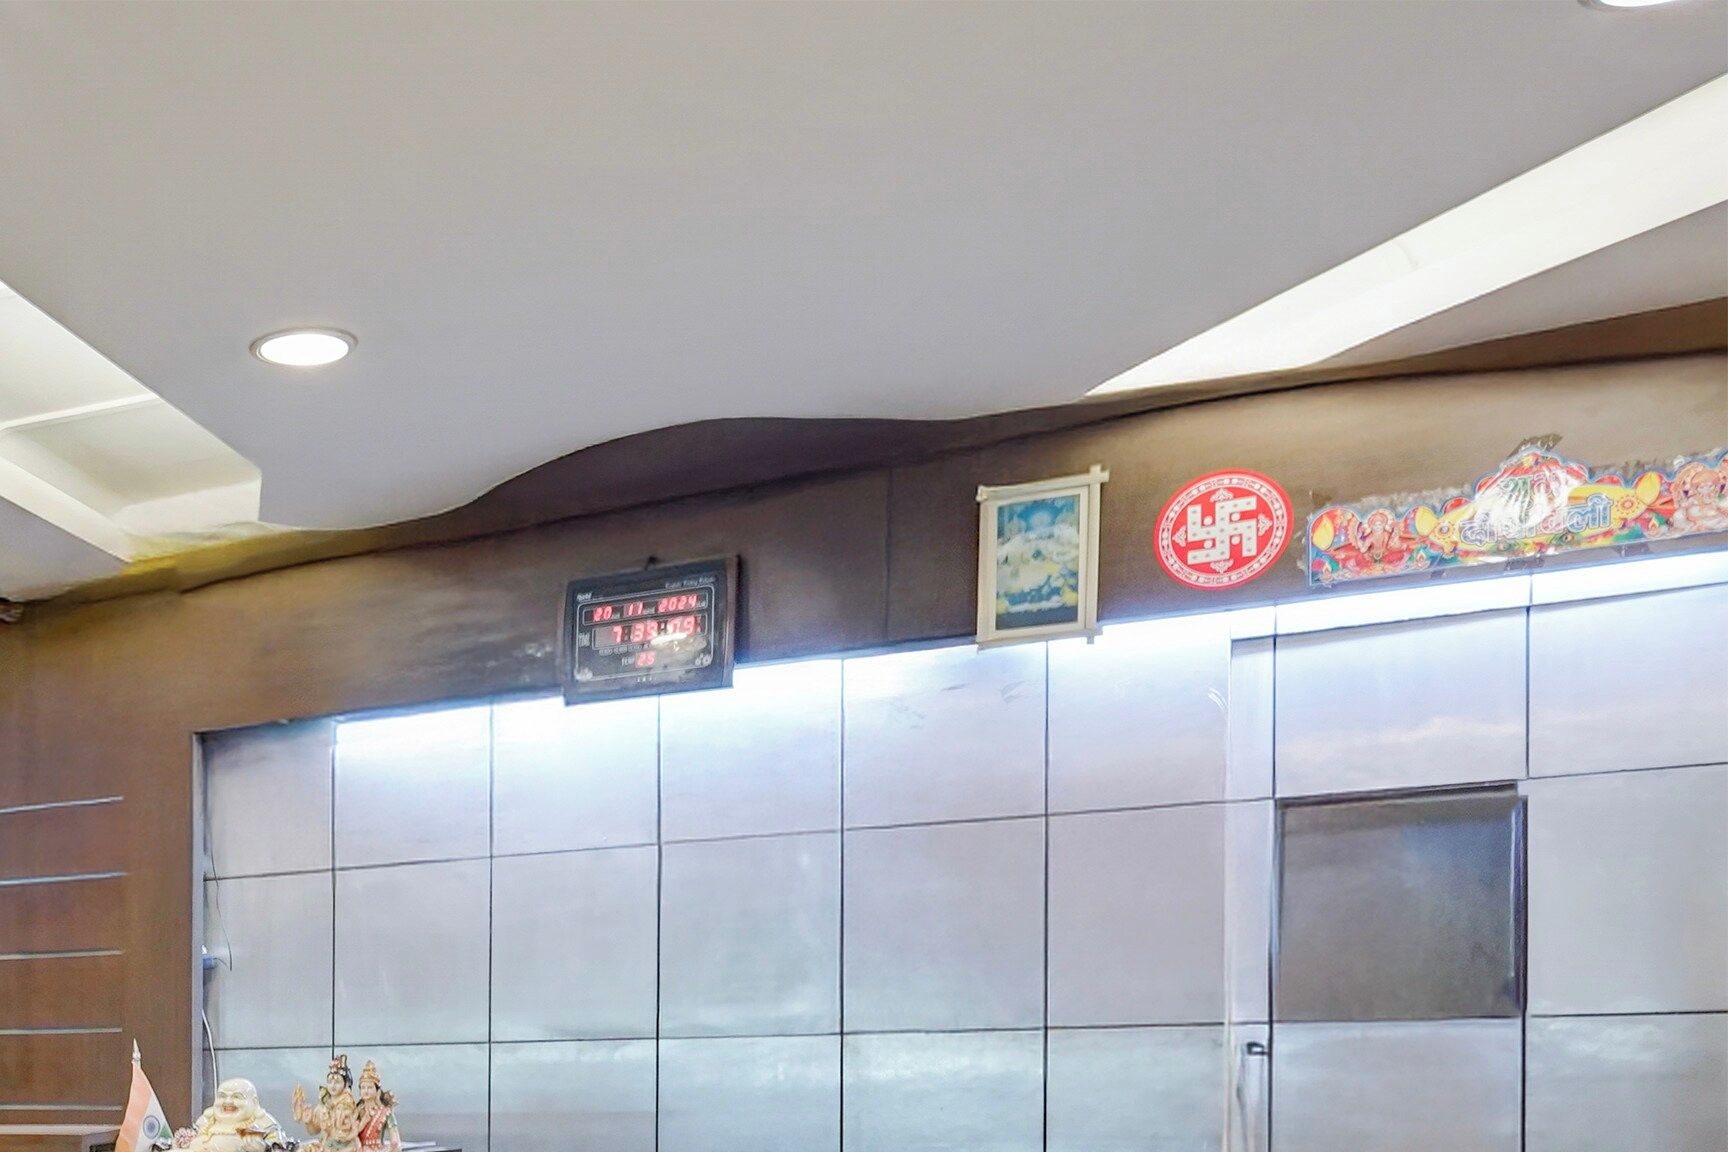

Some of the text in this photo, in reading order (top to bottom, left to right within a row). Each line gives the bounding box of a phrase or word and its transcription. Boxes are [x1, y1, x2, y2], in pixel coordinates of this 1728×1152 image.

[593, 605, 613, 622] 20
[627, 601, 644, 616] 11
[658, 593, 698, 612] 2024
